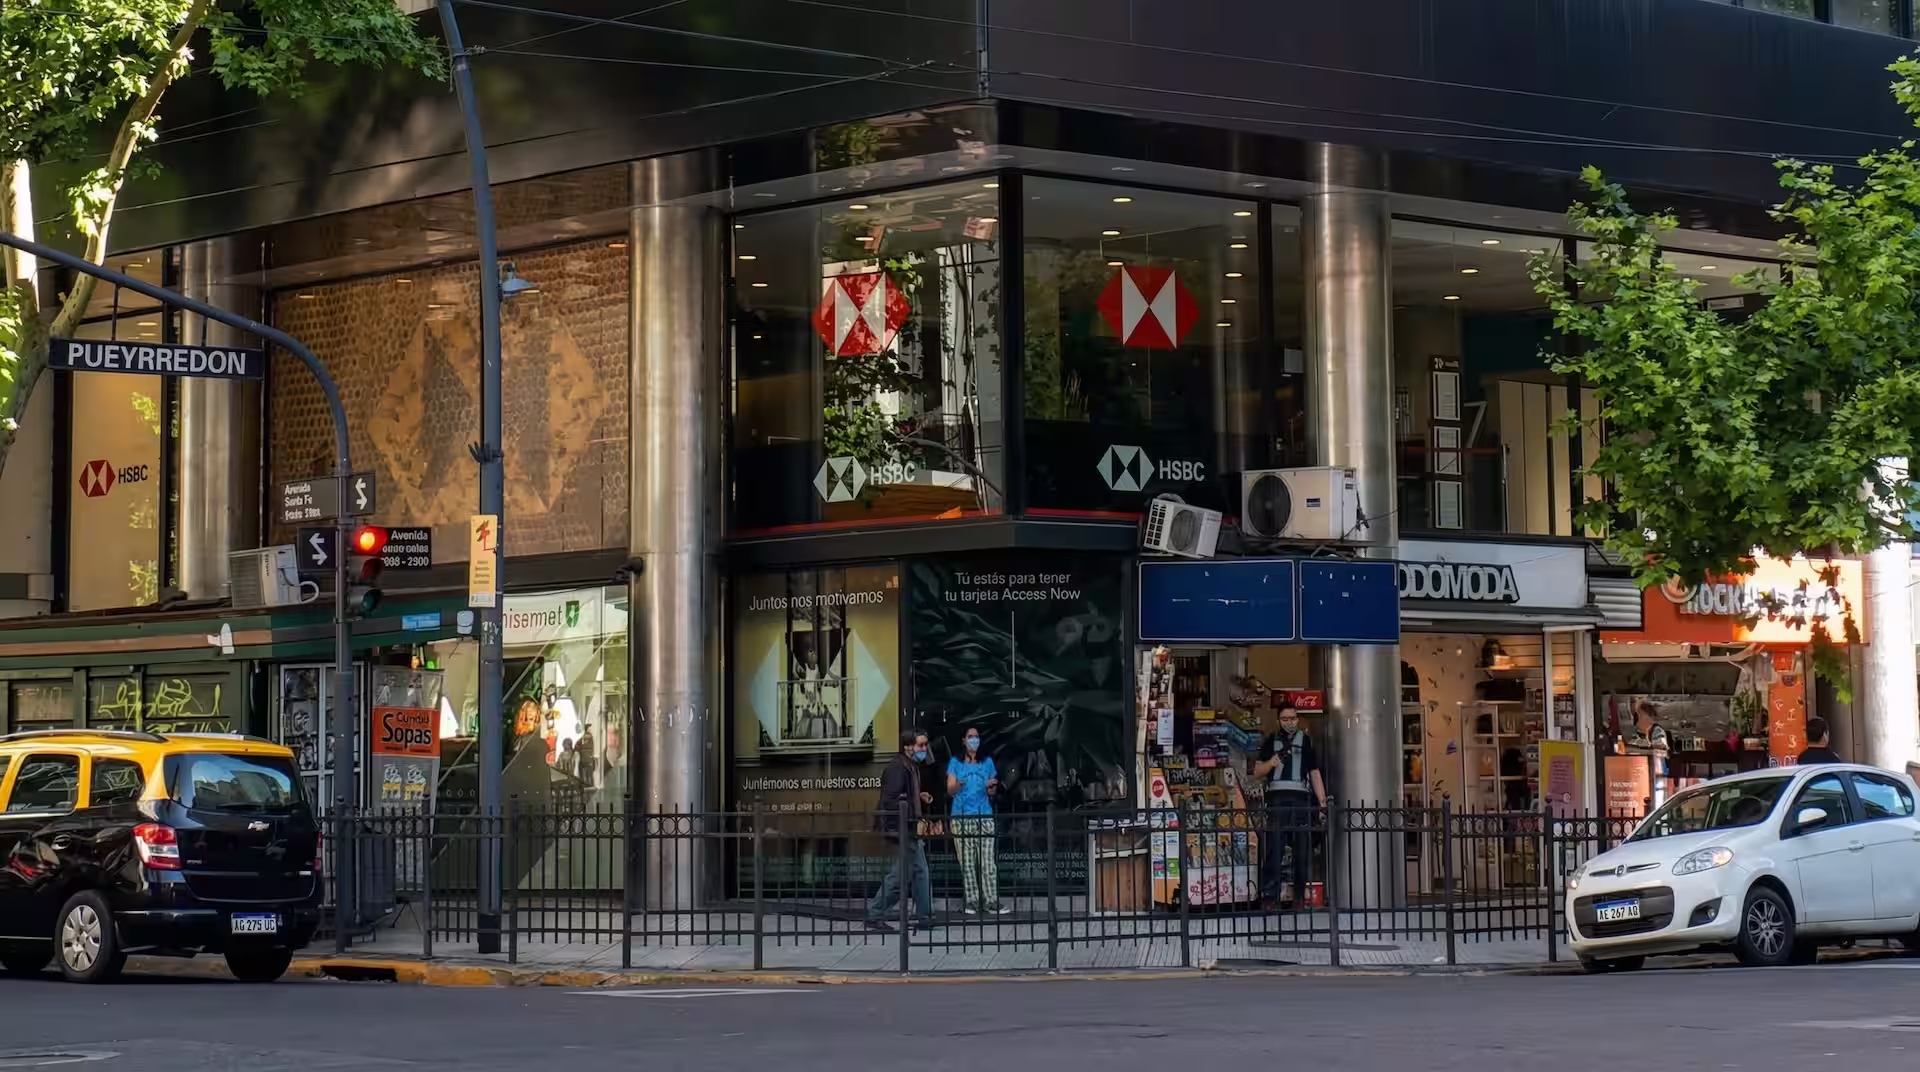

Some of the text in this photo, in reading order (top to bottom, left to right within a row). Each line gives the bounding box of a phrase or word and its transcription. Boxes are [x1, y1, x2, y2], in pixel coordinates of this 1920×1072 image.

[68, 342, 247, 375] PUEYRREDON
[118, 464, 149, 484] HSBC
[870, 462, 917, 486] HSBC
[1160, 459, 1207, 482] HSBC
[391, 530, 429, 541] Avenida
[955, 572, 1071, 588] Tú estás para tener
[749, 588, 884, 610] Juntos nos motivamos
[944, 587, 1081, 604] tu tarjeta Access Now
[382, 713, 432, 749] Sopas
[742, 776, 801, 791] Juntémonos
[801, 779, 814, 789] en
[815, 776, 857, 790] nuestros
[1599, 909, 1609, 920] AE
[1610, 906, 1625, 919] 267
[234, 920, 245, 931] AG
[247, 920, 262, 931] 275
